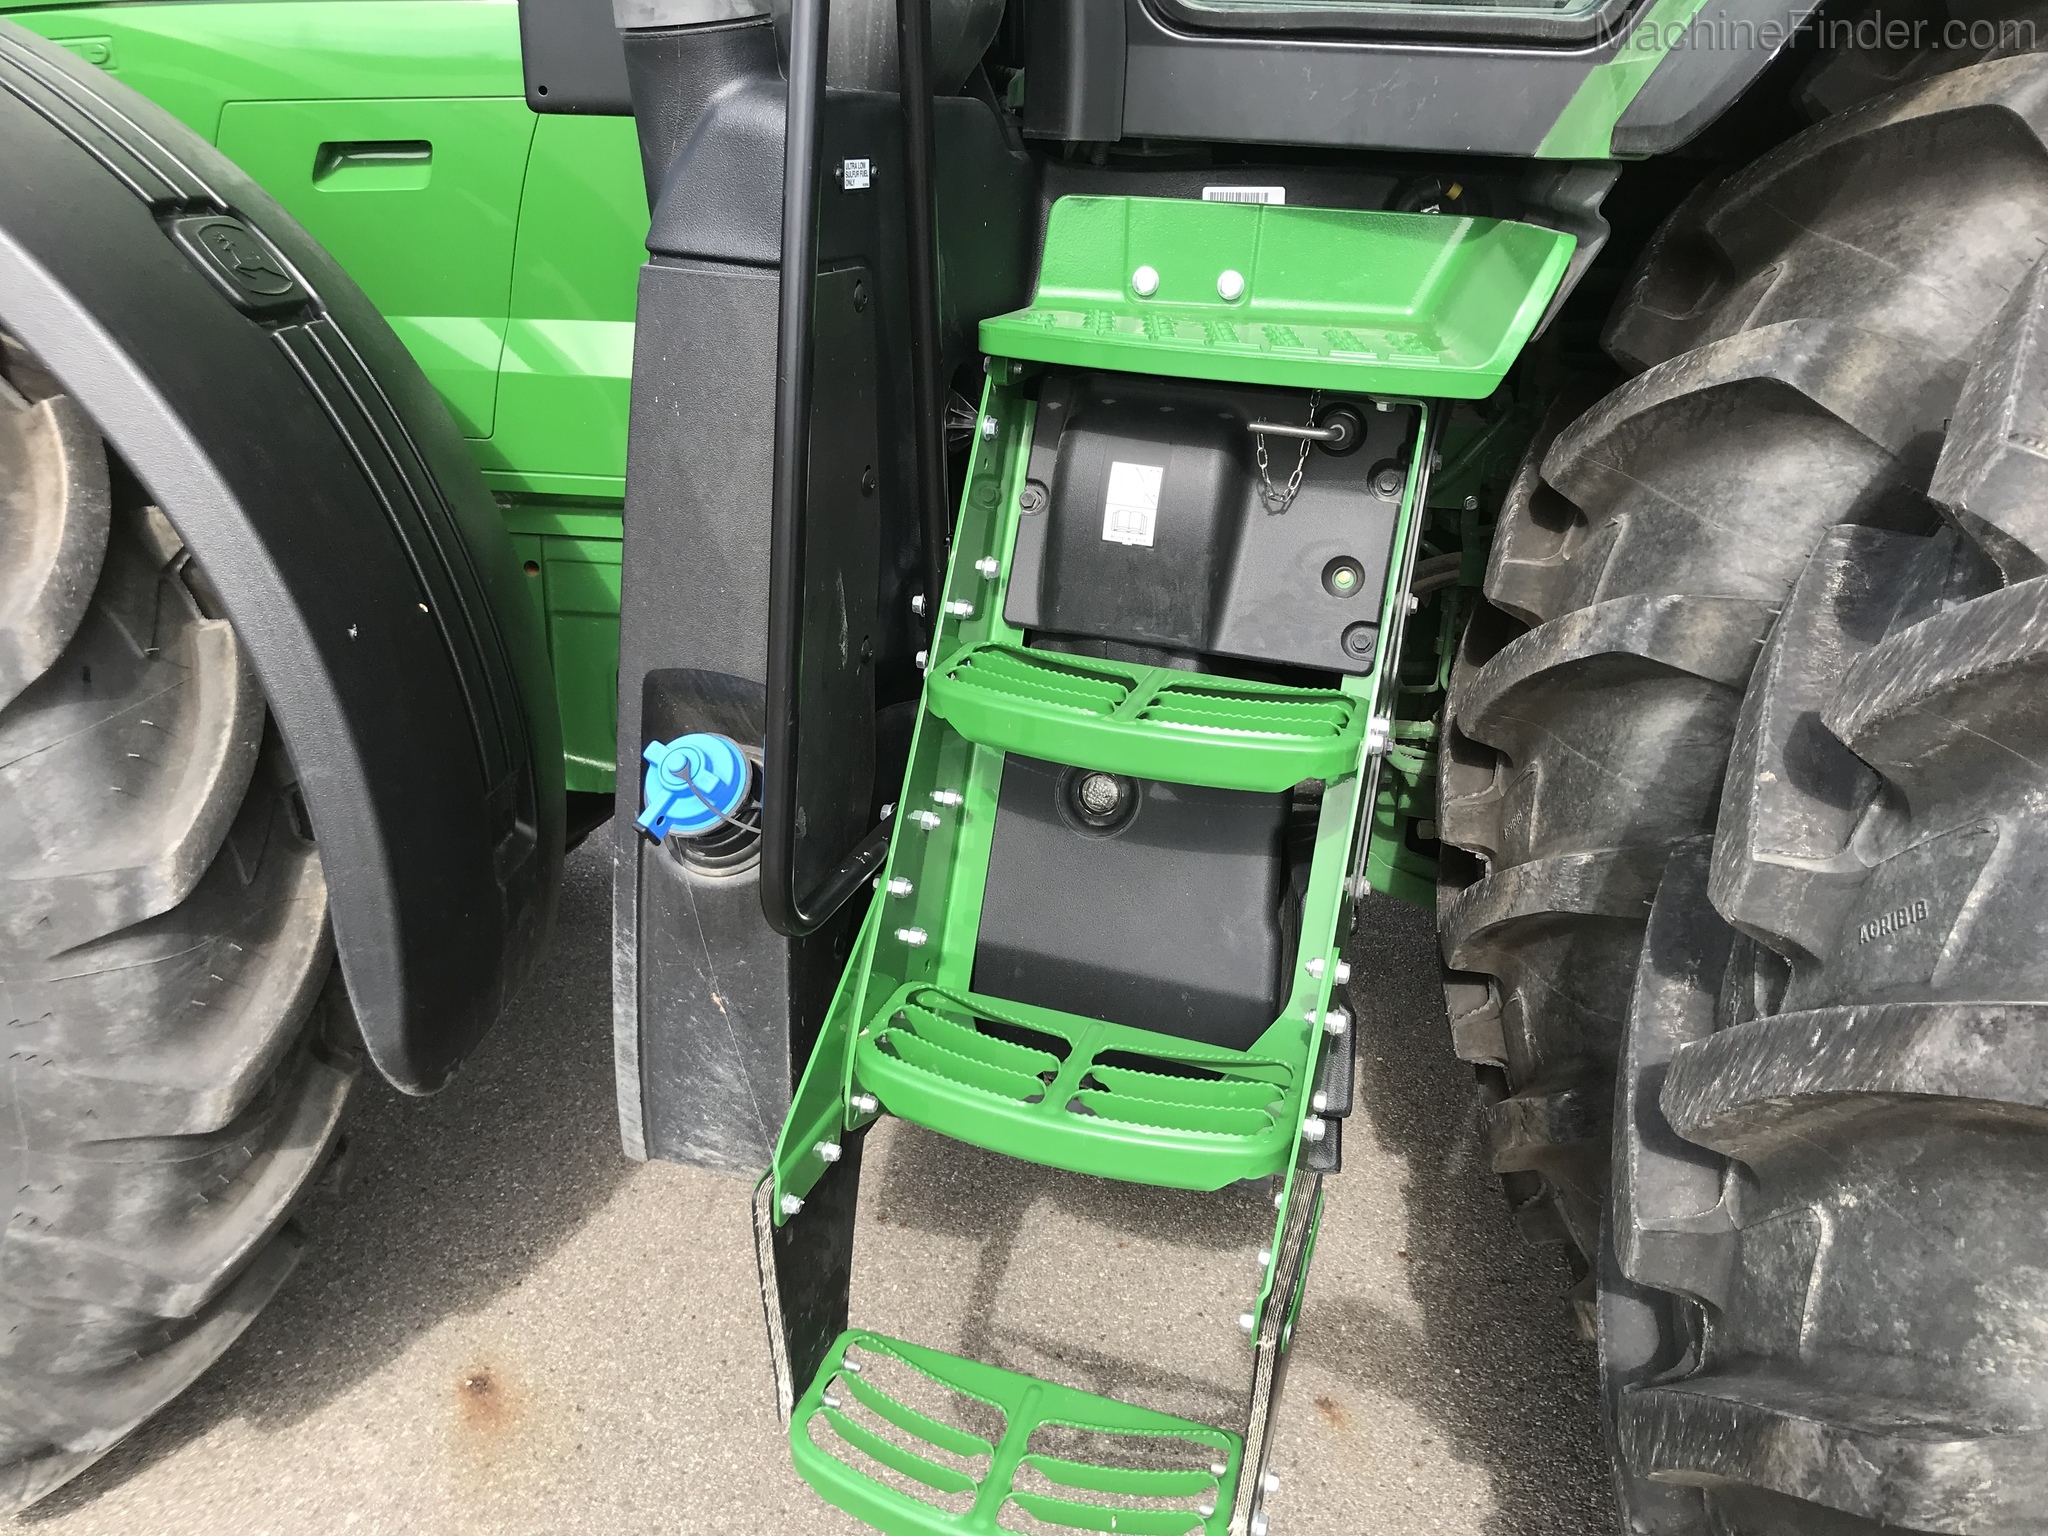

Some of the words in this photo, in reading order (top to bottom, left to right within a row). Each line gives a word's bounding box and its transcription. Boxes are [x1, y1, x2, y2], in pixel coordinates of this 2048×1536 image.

[846, 162, 857, 170] ULTRA
[846, 170, 859, 178] SULFUR
[1858, 898, 1928, 945] AGRIBIB
